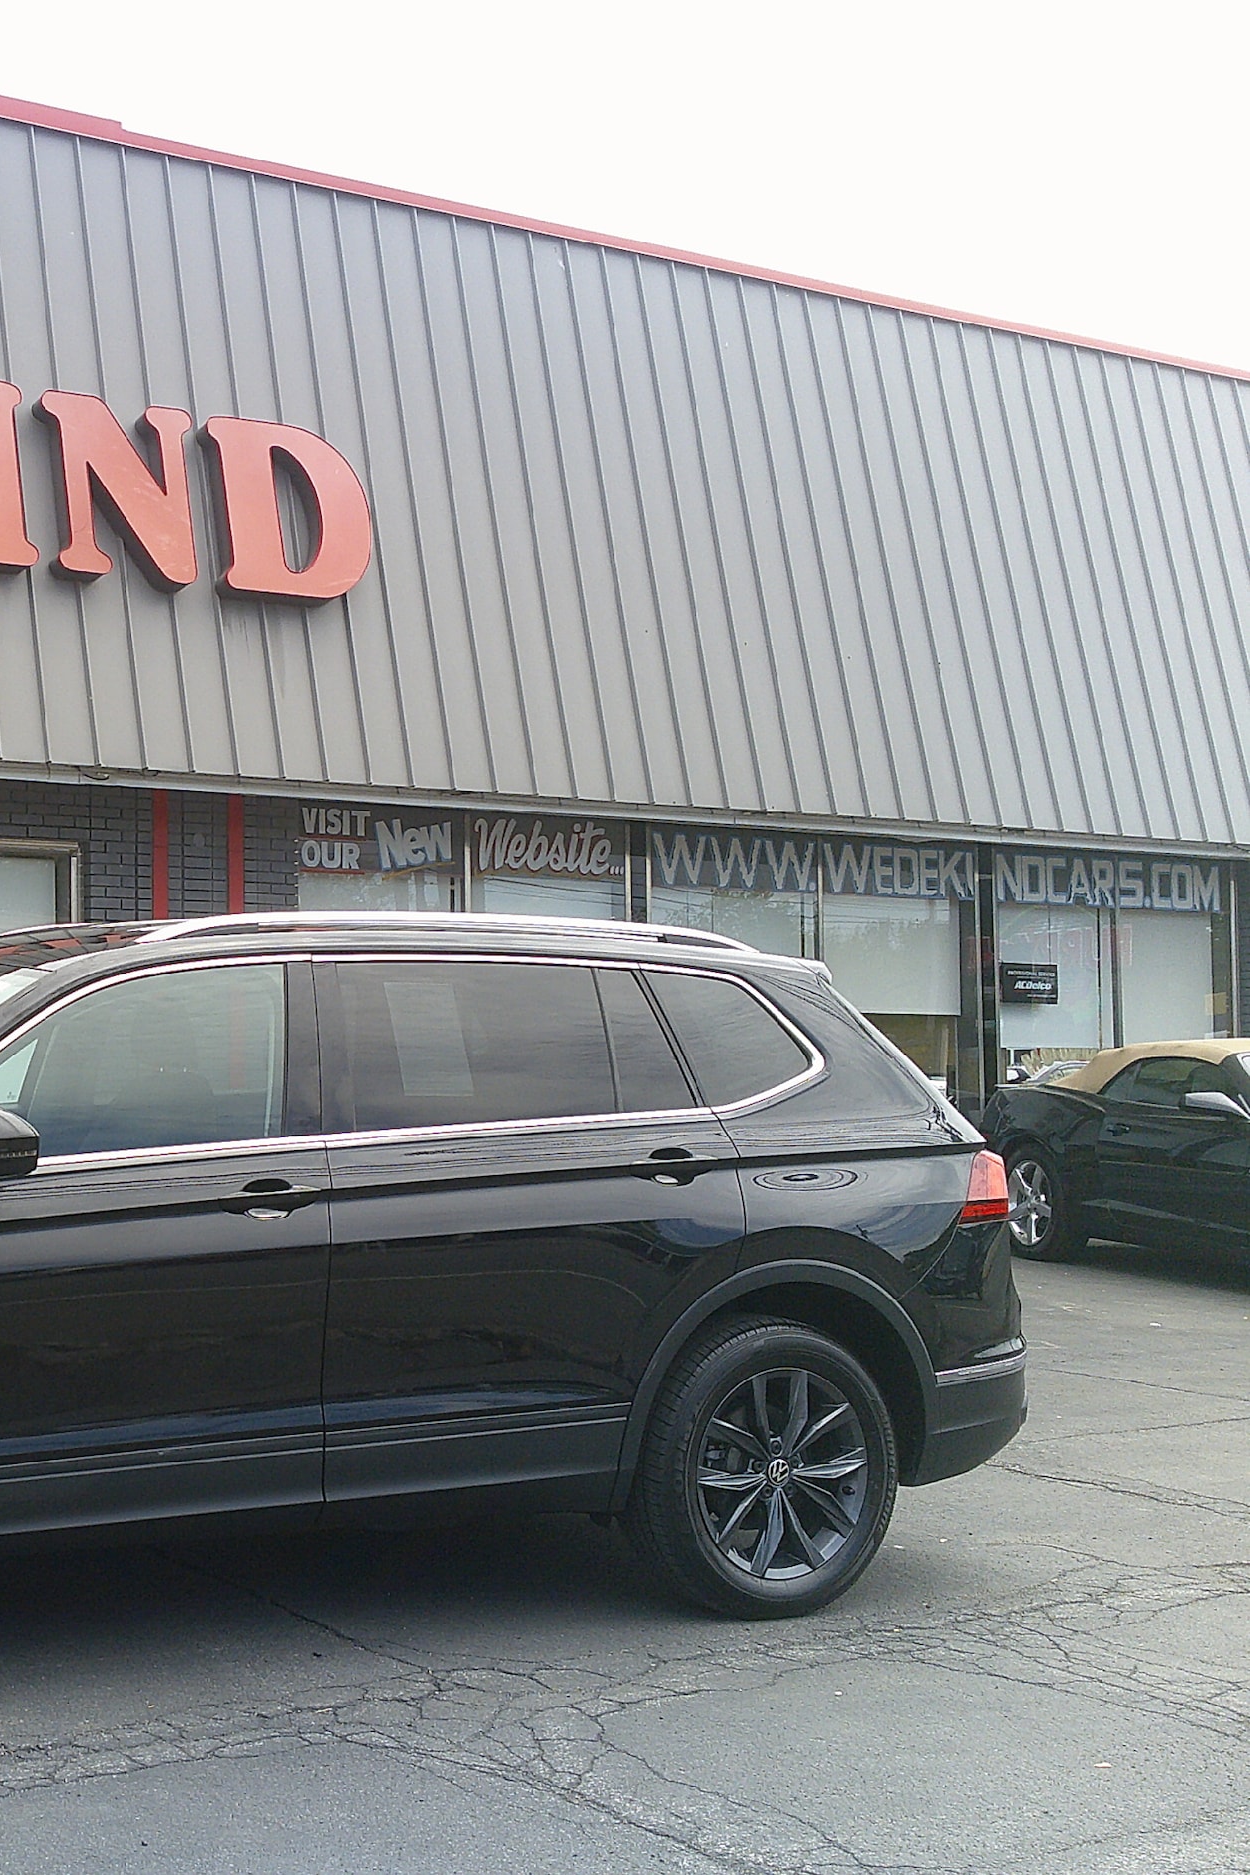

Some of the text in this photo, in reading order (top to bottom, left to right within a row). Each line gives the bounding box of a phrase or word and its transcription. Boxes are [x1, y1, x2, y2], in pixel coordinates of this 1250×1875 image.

[302, 807, 370, 837] VISIT
[301, 841, 360, 870] OUR
[375, 818, 452, 871] New
